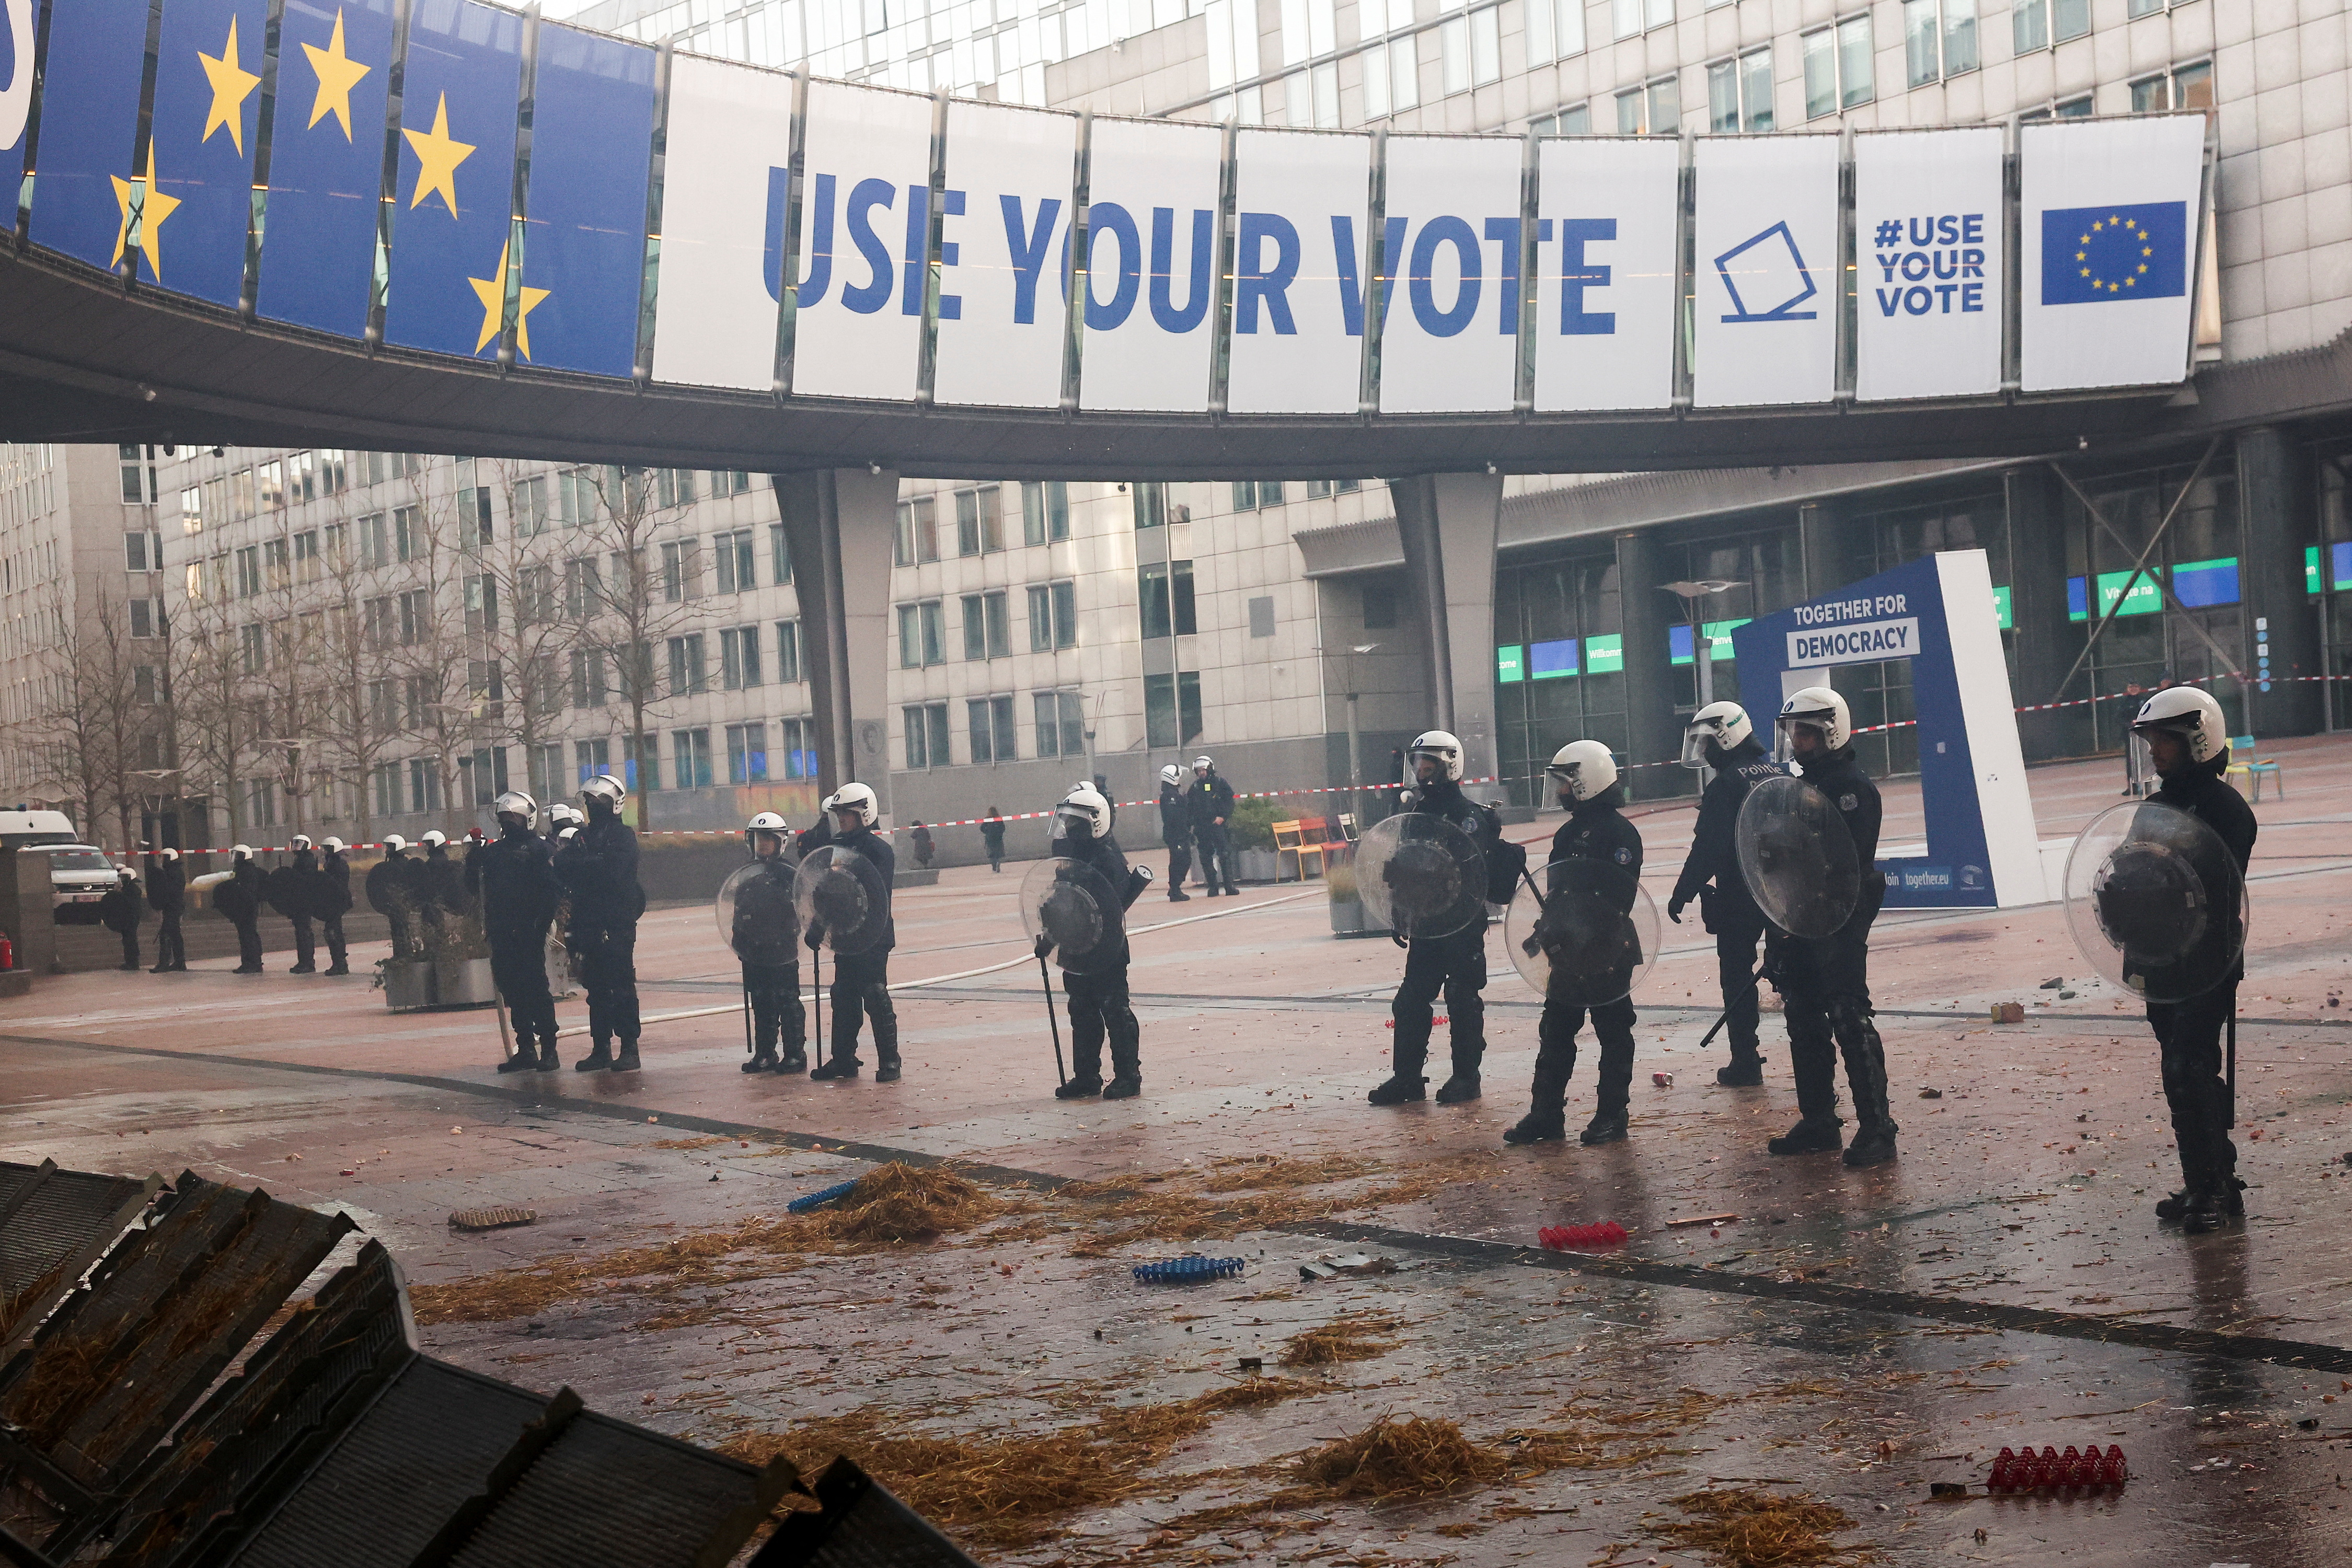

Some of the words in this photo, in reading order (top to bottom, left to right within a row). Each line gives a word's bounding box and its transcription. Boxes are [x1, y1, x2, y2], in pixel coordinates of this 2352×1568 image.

[1874, 214, 1984, 248] #USE
[764, 167, 966, 320] USE
[999, 194, 1300, 335] YOUR
[1331, 216, 1617, 338] VOTE
[1876, 249, 1985, 283] YOUR
[1876, 283, 1983, 317] VOTE
[2141, 585, 2153, 595] na
[1793, 598, 1872, 625] TOGETHER
[1875, 594, 1907, 615] FOR
[1706, 636, 1733, 645] ienve
[1796, 626, 1907, 659] DEMOCRACY
[1738, 764, 1784, 778] Politie
[1905, 871, 1949, 889] together.eu
